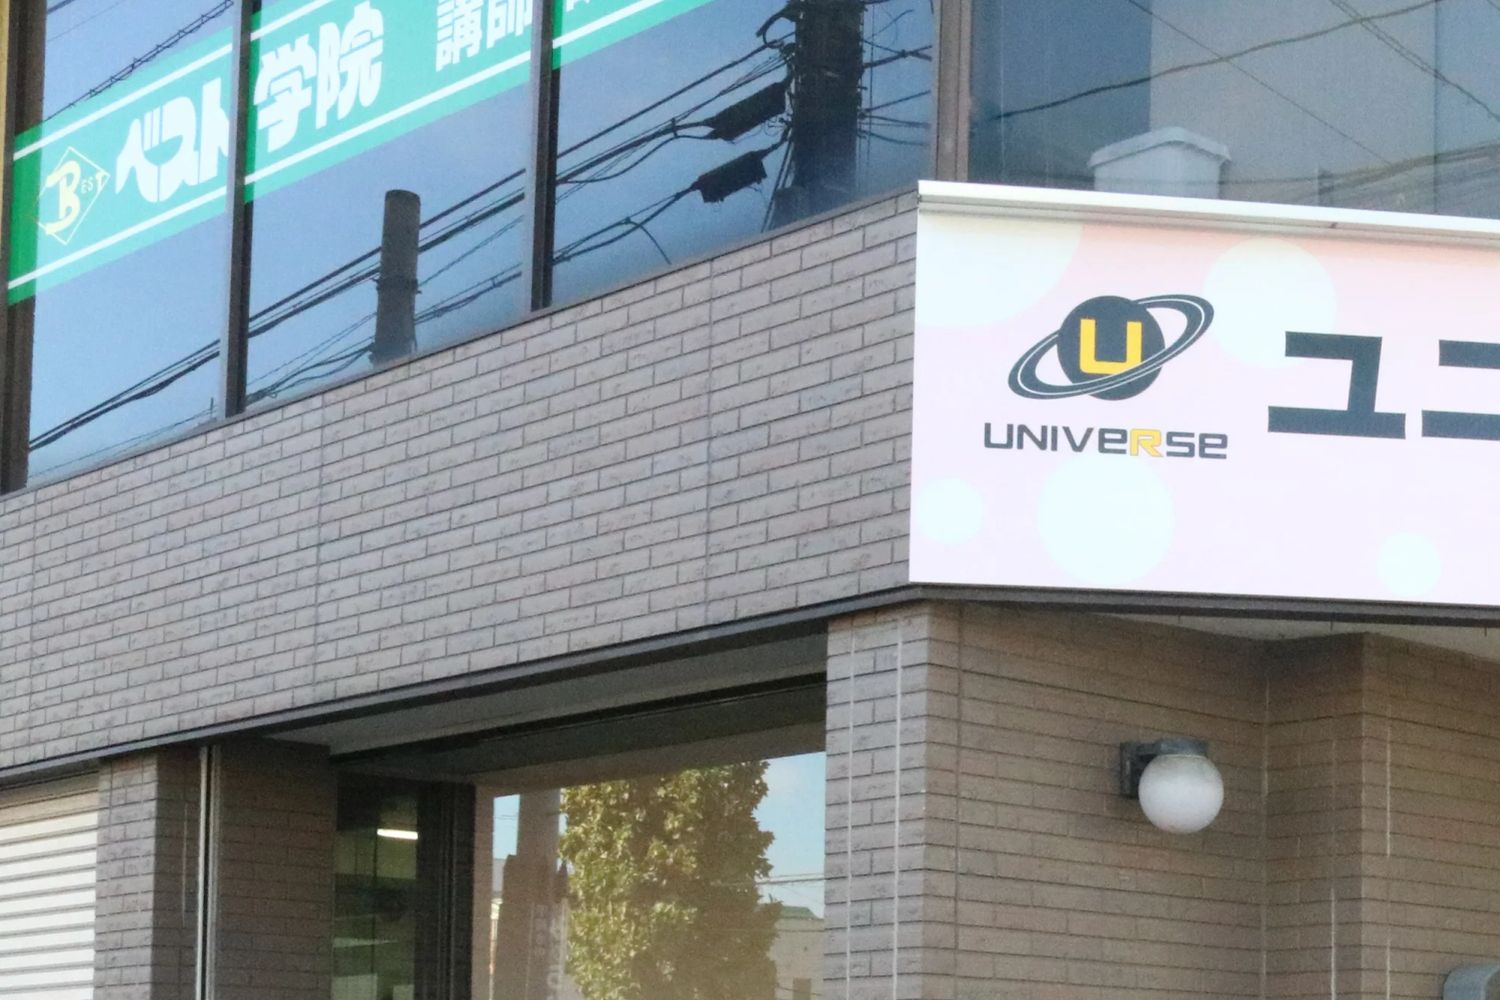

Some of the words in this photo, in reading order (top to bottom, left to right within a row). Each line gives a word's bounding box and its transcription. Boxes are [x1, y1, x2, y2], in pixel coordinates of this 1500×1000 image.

[115, 0, 384, 203] ベスト学院
